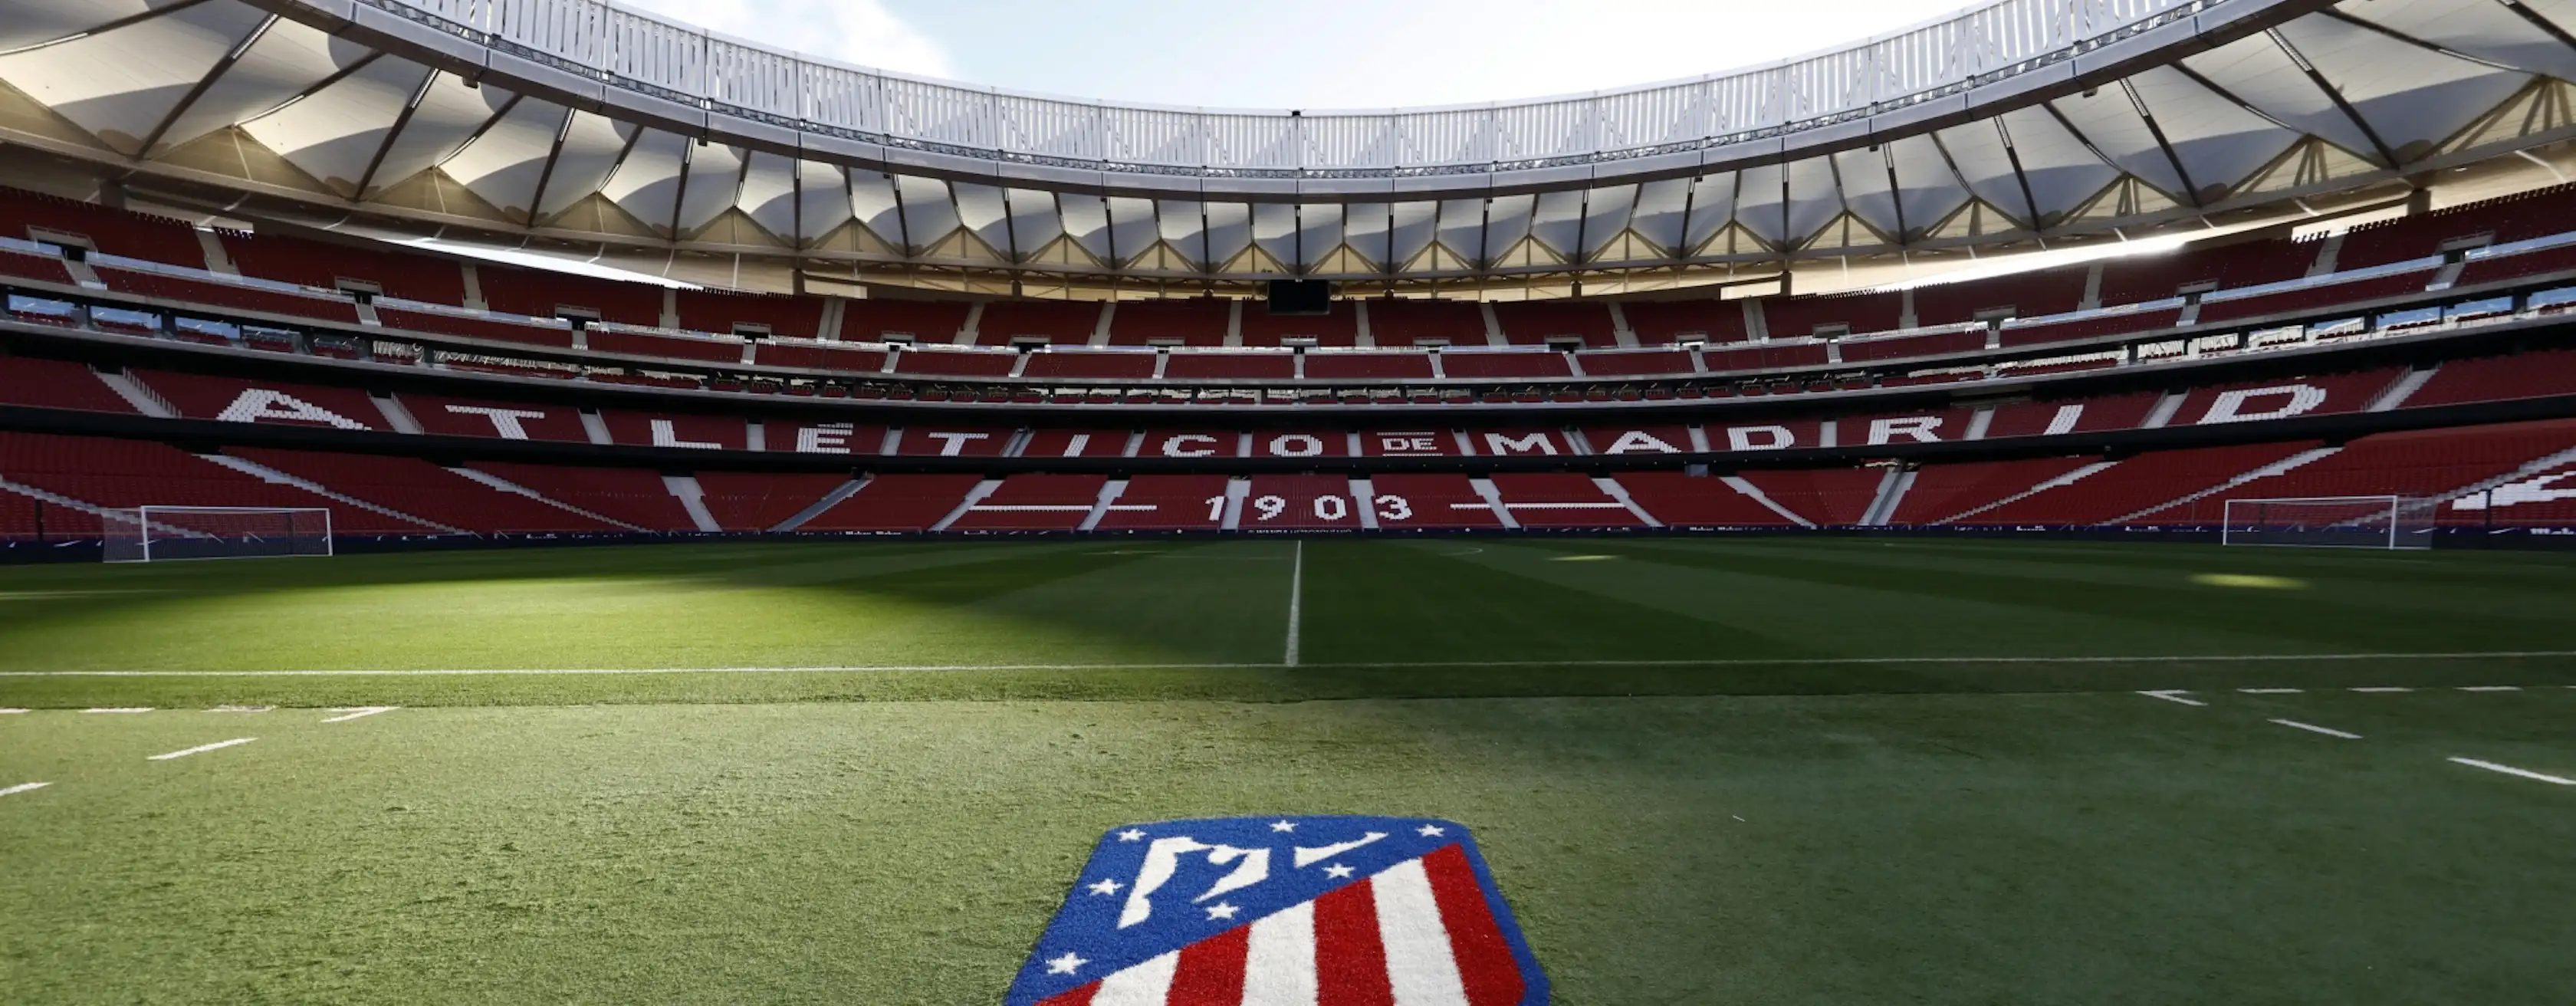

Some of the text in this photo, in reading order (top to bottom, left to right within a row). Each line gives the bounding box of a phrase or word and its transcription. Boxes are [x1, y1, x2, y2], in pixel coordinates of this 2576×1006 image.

[217, 385, 2326, 458] ATLÉTICO DE MADRID
[1205, 495, 1413, 521] 1903
